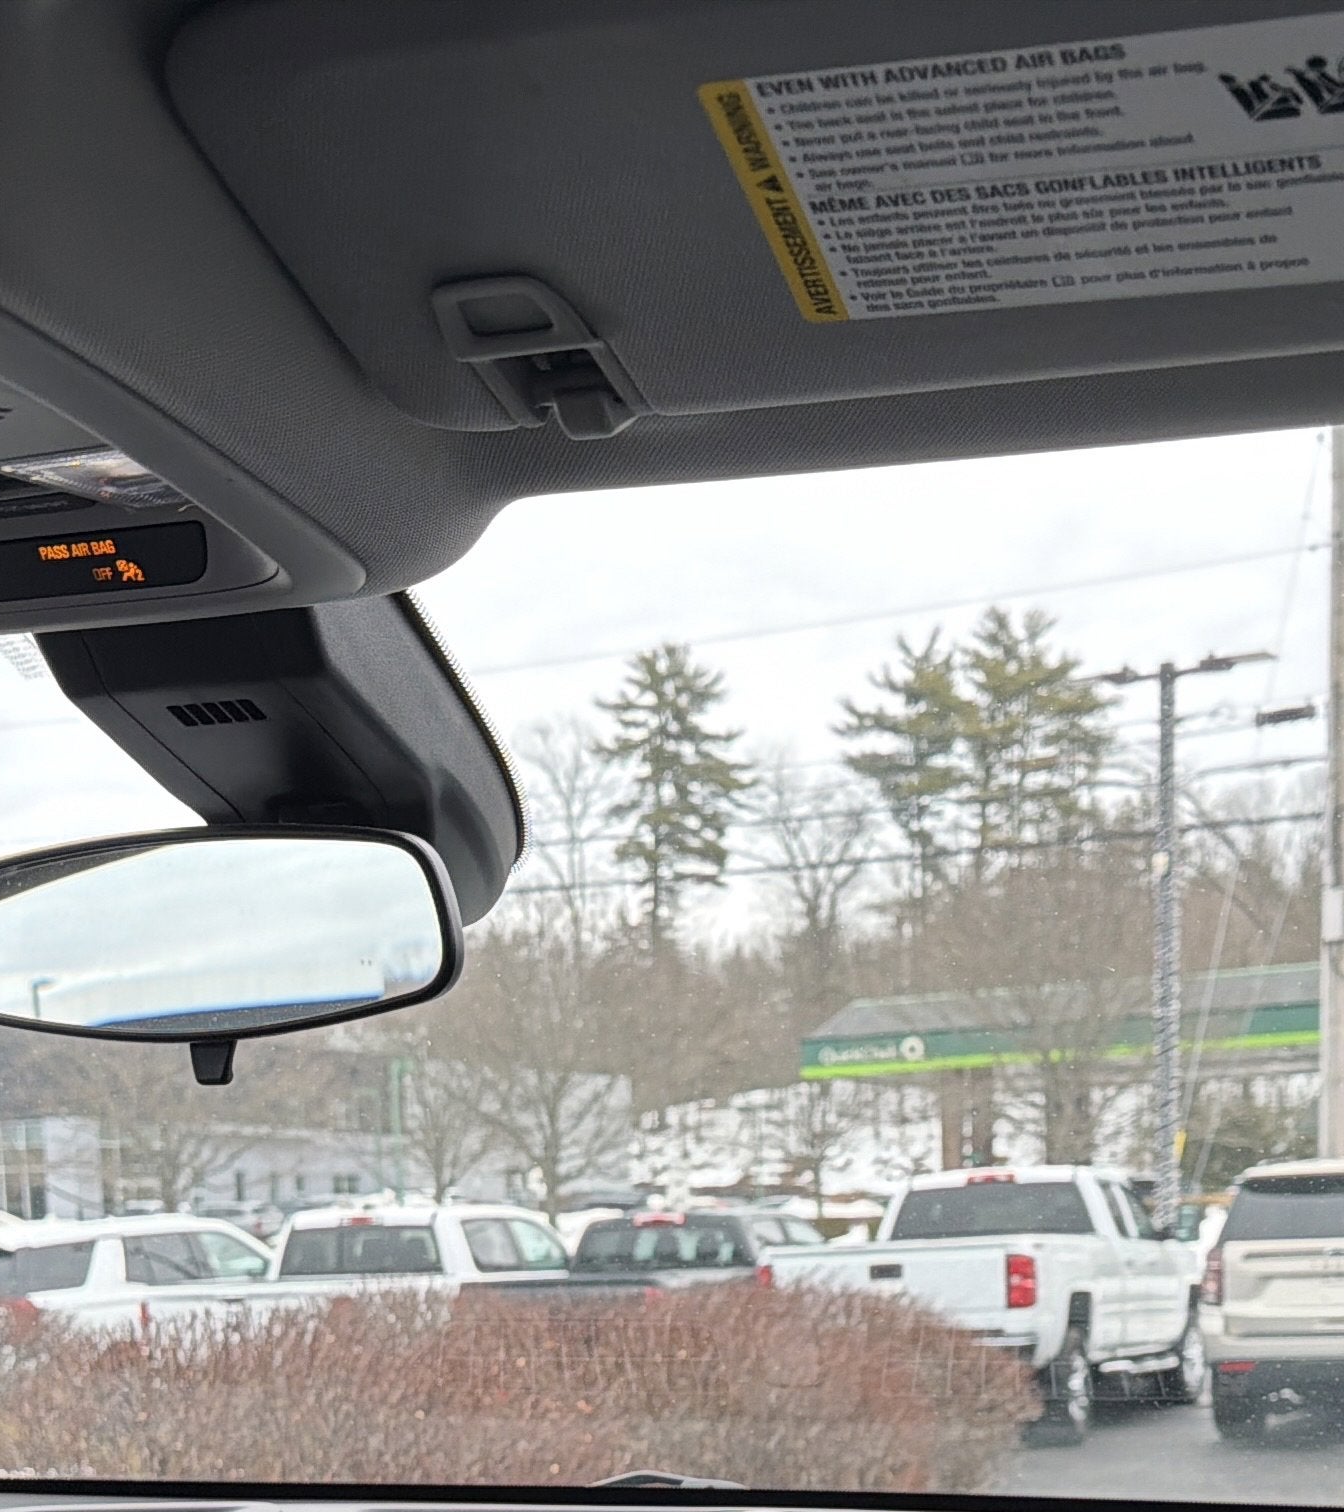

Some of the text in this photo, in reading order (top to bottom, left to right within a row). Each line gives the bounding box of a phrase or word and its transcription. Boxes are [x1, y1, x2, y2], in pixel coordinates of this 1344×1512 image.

[754, 44, 1127, 97] EVEN WITH ADVANCED AIR BAGS
[717, 91, 836, 316] AVERTISSEMENT WARNING
[806, 154, 1323, 215] MÊME AVEC DES SACS GONFLABLES INTELLIGENTS
[38, 540, 116, 560] PASS AIR BAG
[92, 567, 113, 581] OFF
